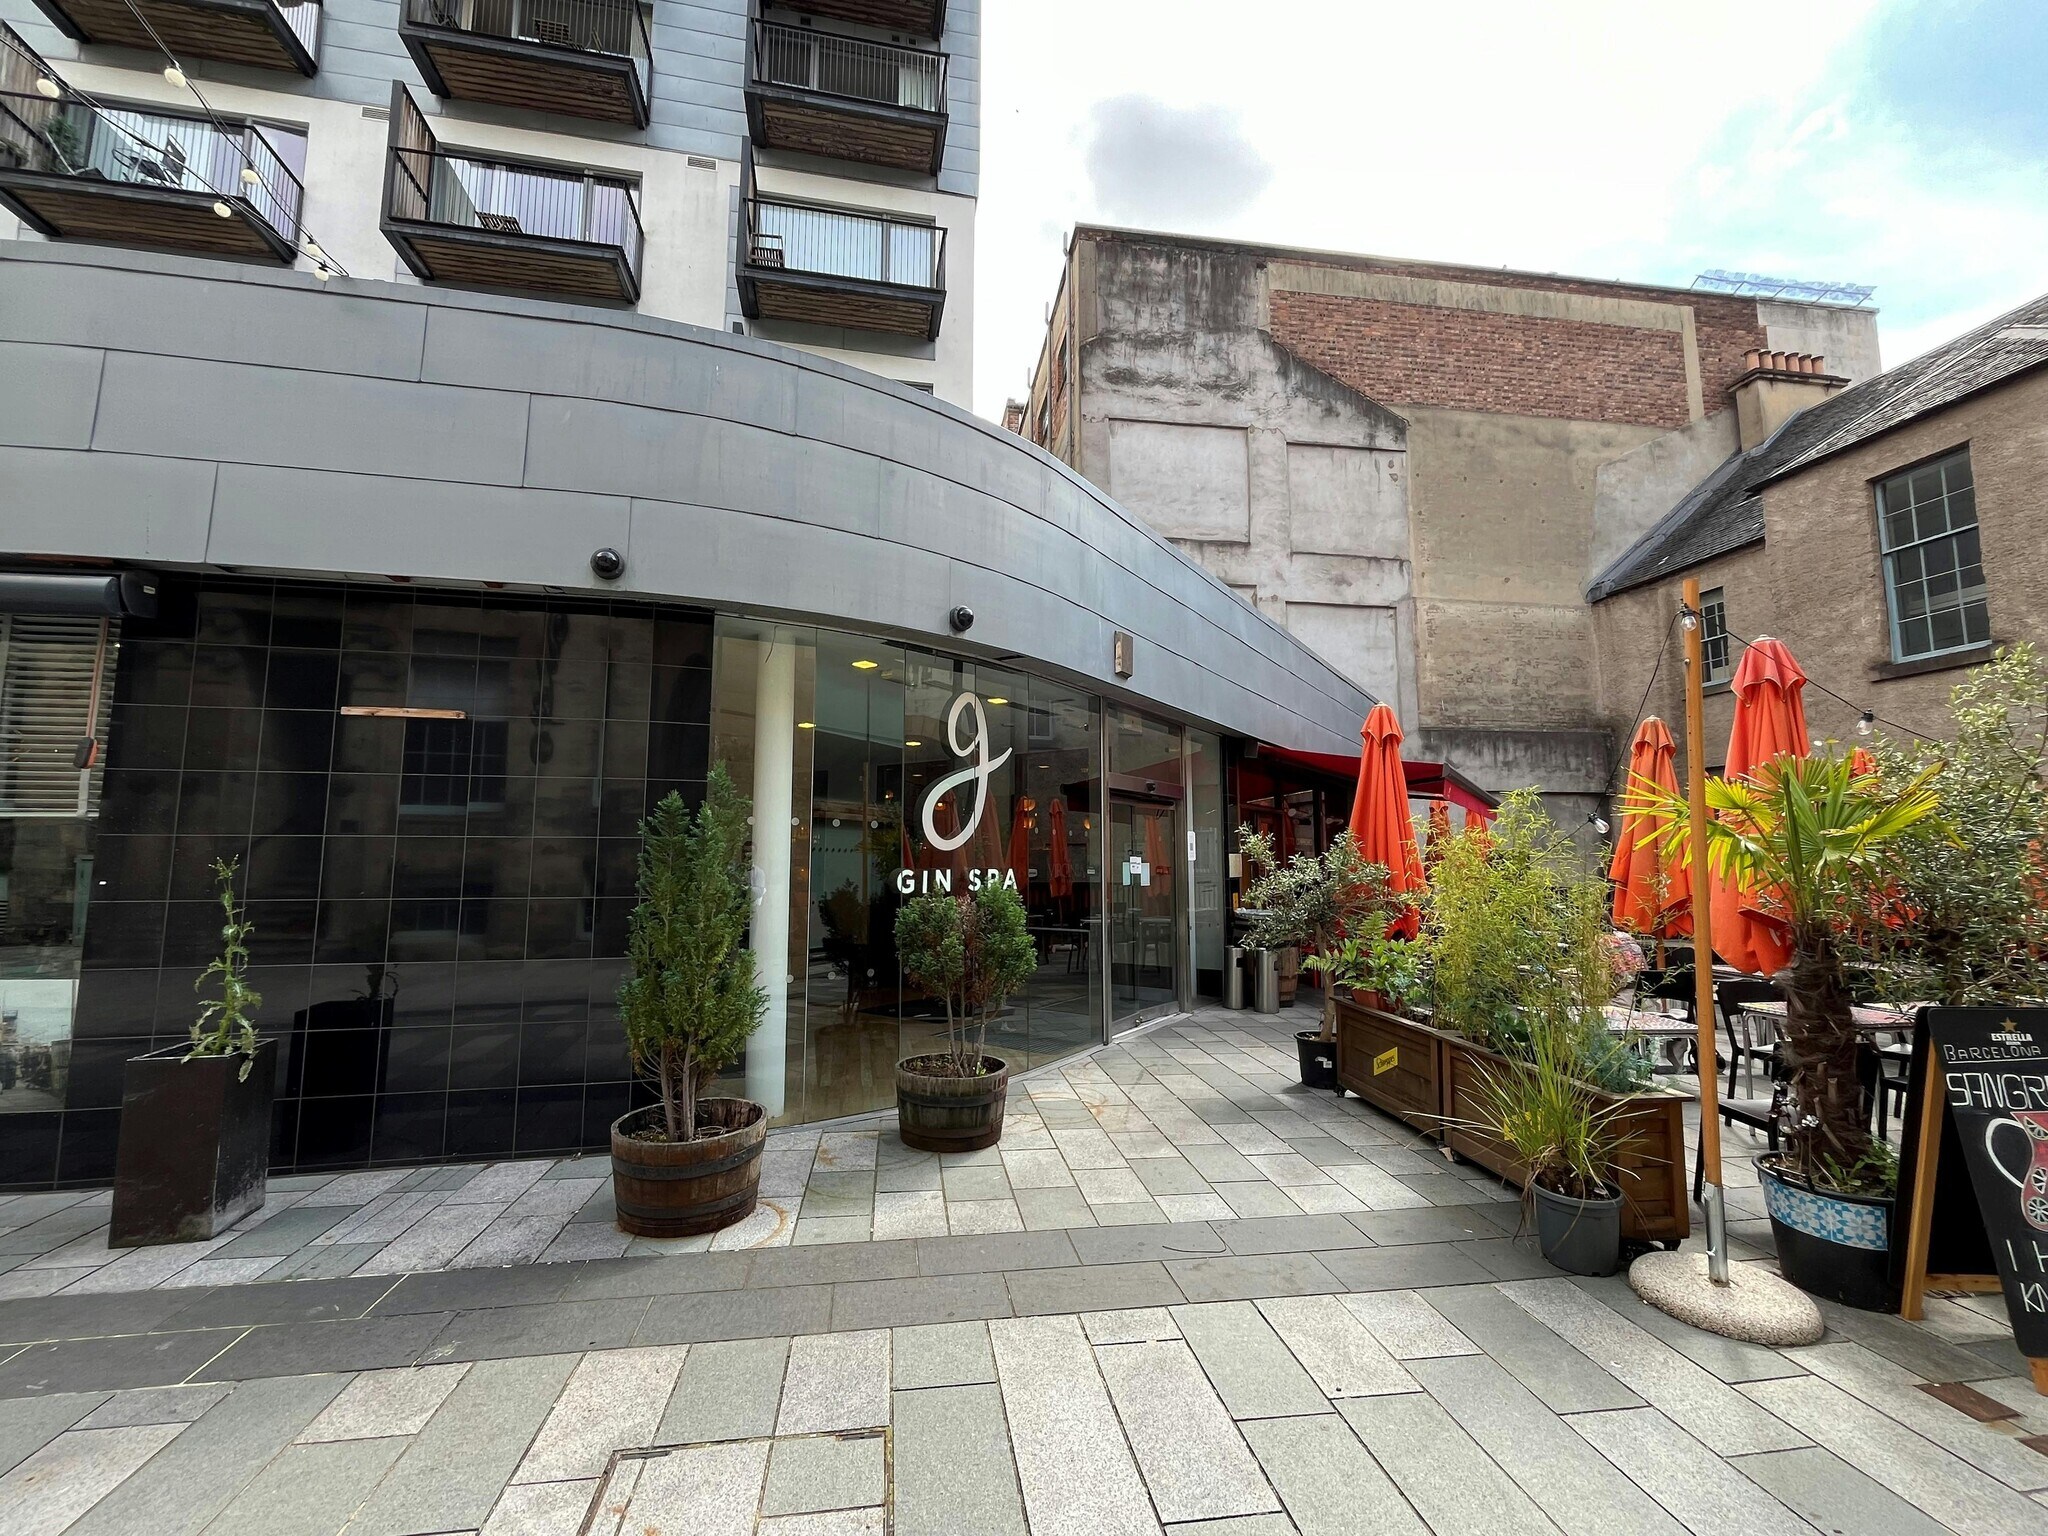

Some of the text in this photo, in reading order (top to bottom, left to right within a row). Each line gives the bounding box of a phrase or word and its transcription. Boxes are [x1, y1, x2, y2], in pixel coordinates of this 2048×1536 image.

[896, 868, 952, 895] GIN
[967, 867, 1018, 892] SPA
[1990, 1033, 2034, 1042] ESTRELLA
[1945, 1072, 2048, 1110] SANGR
